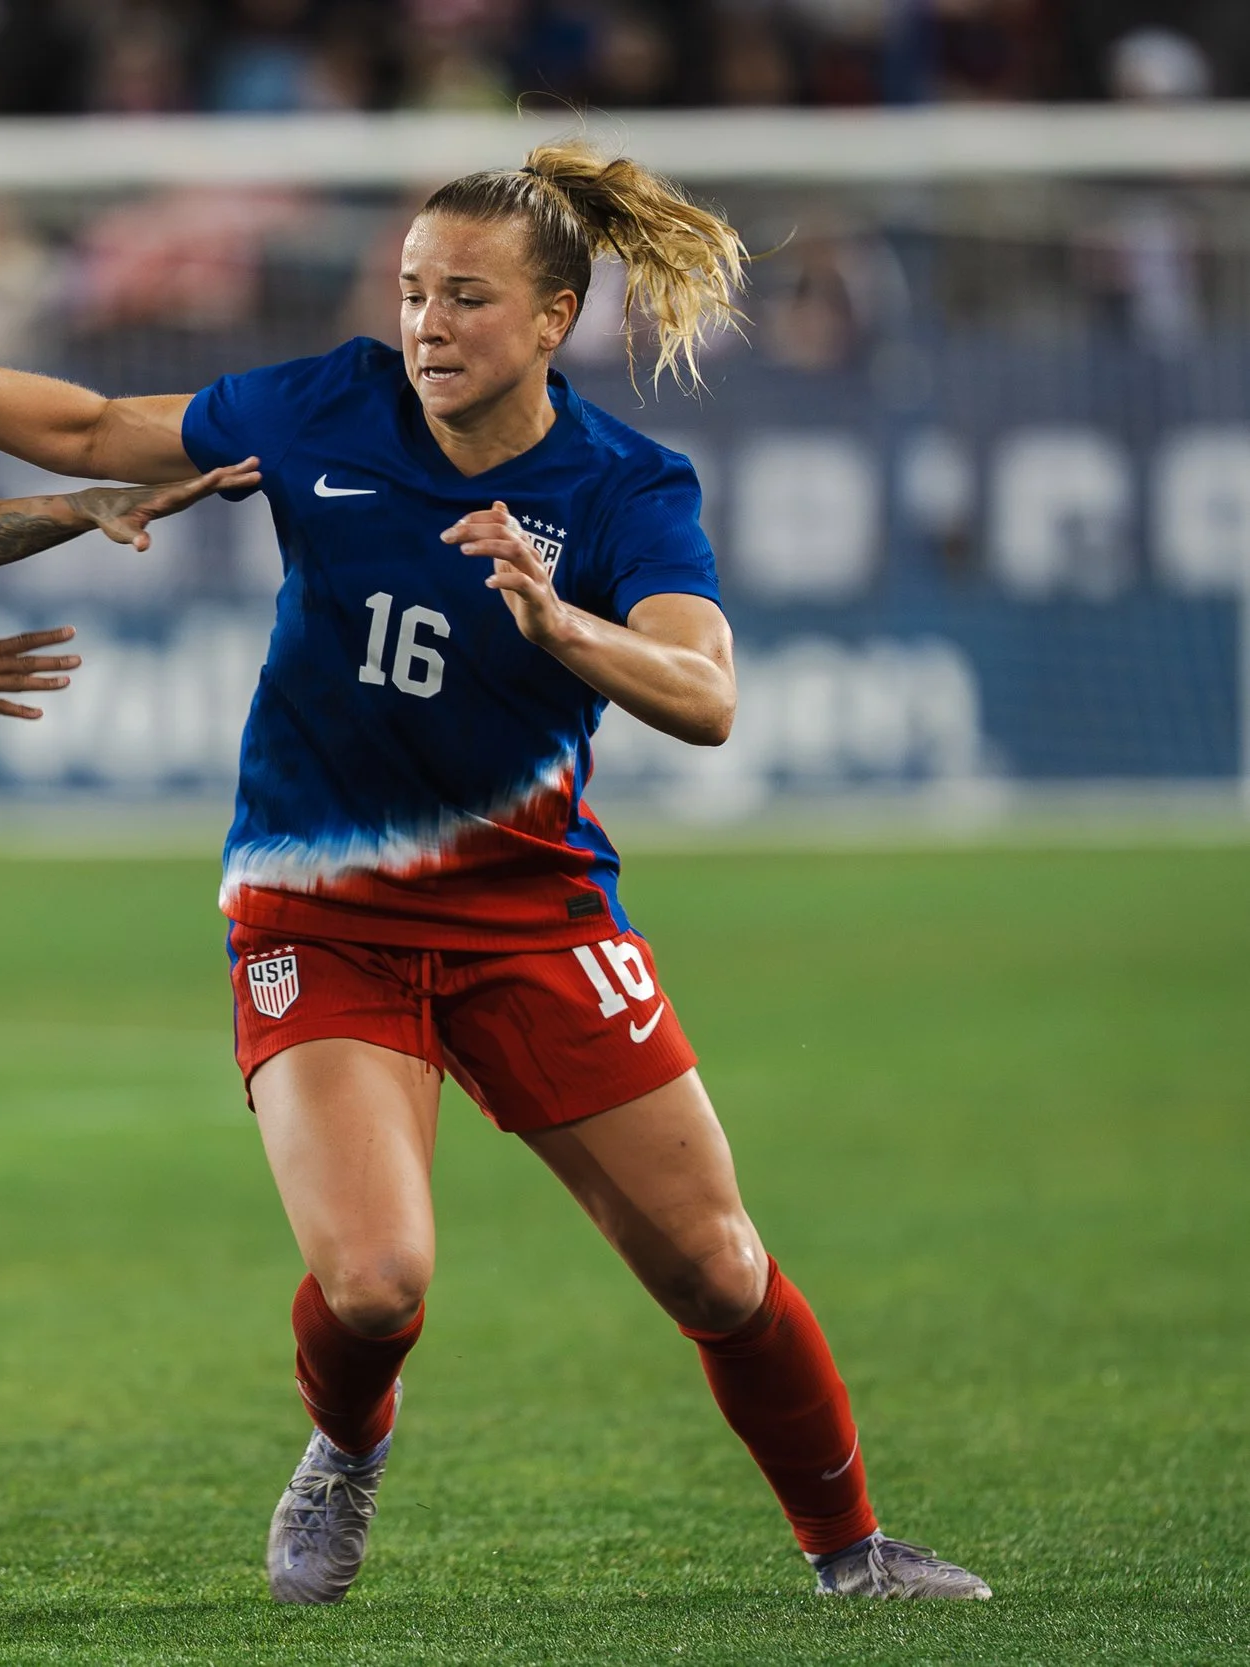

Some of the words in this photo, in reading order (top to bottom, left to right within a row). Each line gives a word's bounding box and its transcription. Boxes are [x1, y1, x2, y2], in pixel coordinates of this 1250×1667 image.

[529, 535, 560, 563] SA
[358, 591, 451, 699] 16
[251, 959, 294, 984] USA
[572, 939, 655, 1019] 16
